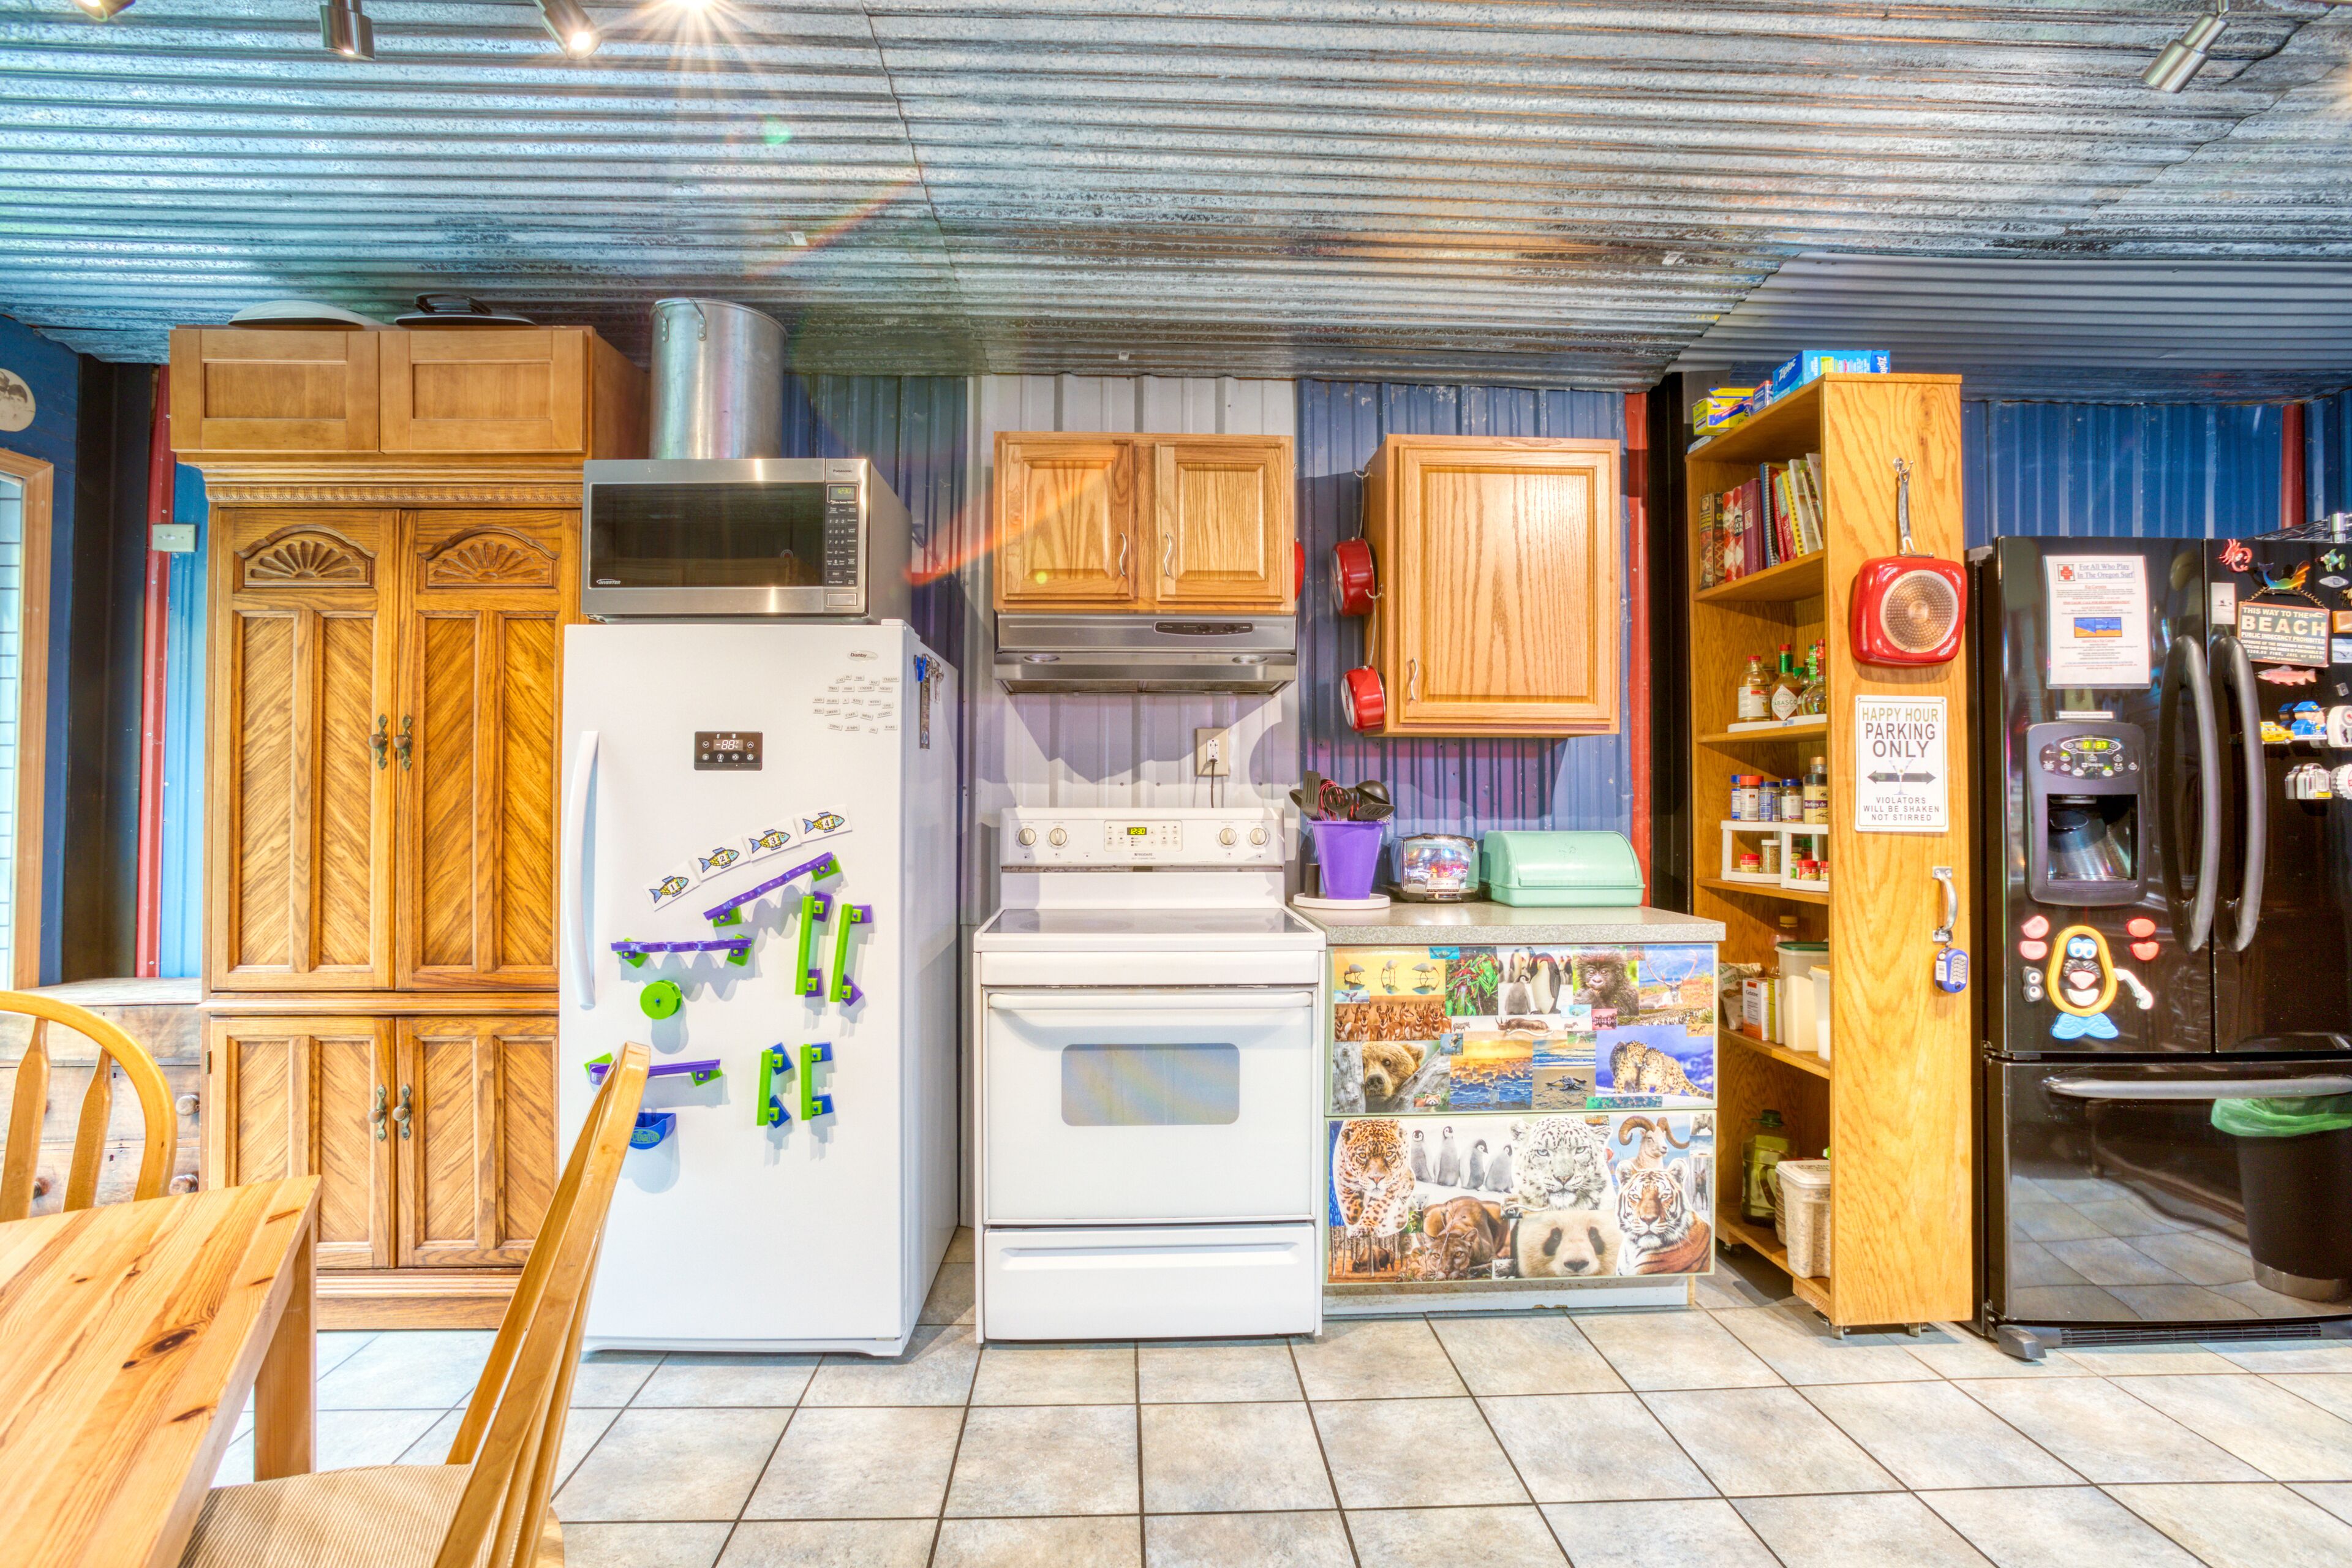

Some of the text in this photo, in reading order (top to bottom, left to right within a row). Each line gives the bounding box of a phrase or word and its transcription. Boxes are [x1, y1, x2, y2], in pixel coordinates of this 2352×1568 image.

[1778, 358, 1796, 382] Ziploc
[2241, 615, 2326, 637] BEACH
[1862, 707, 1939, 722] HAPPY HOUR
[1866, 723, 1936, 740] PARKING
[1873, 740, 1929, 758] ONLY
